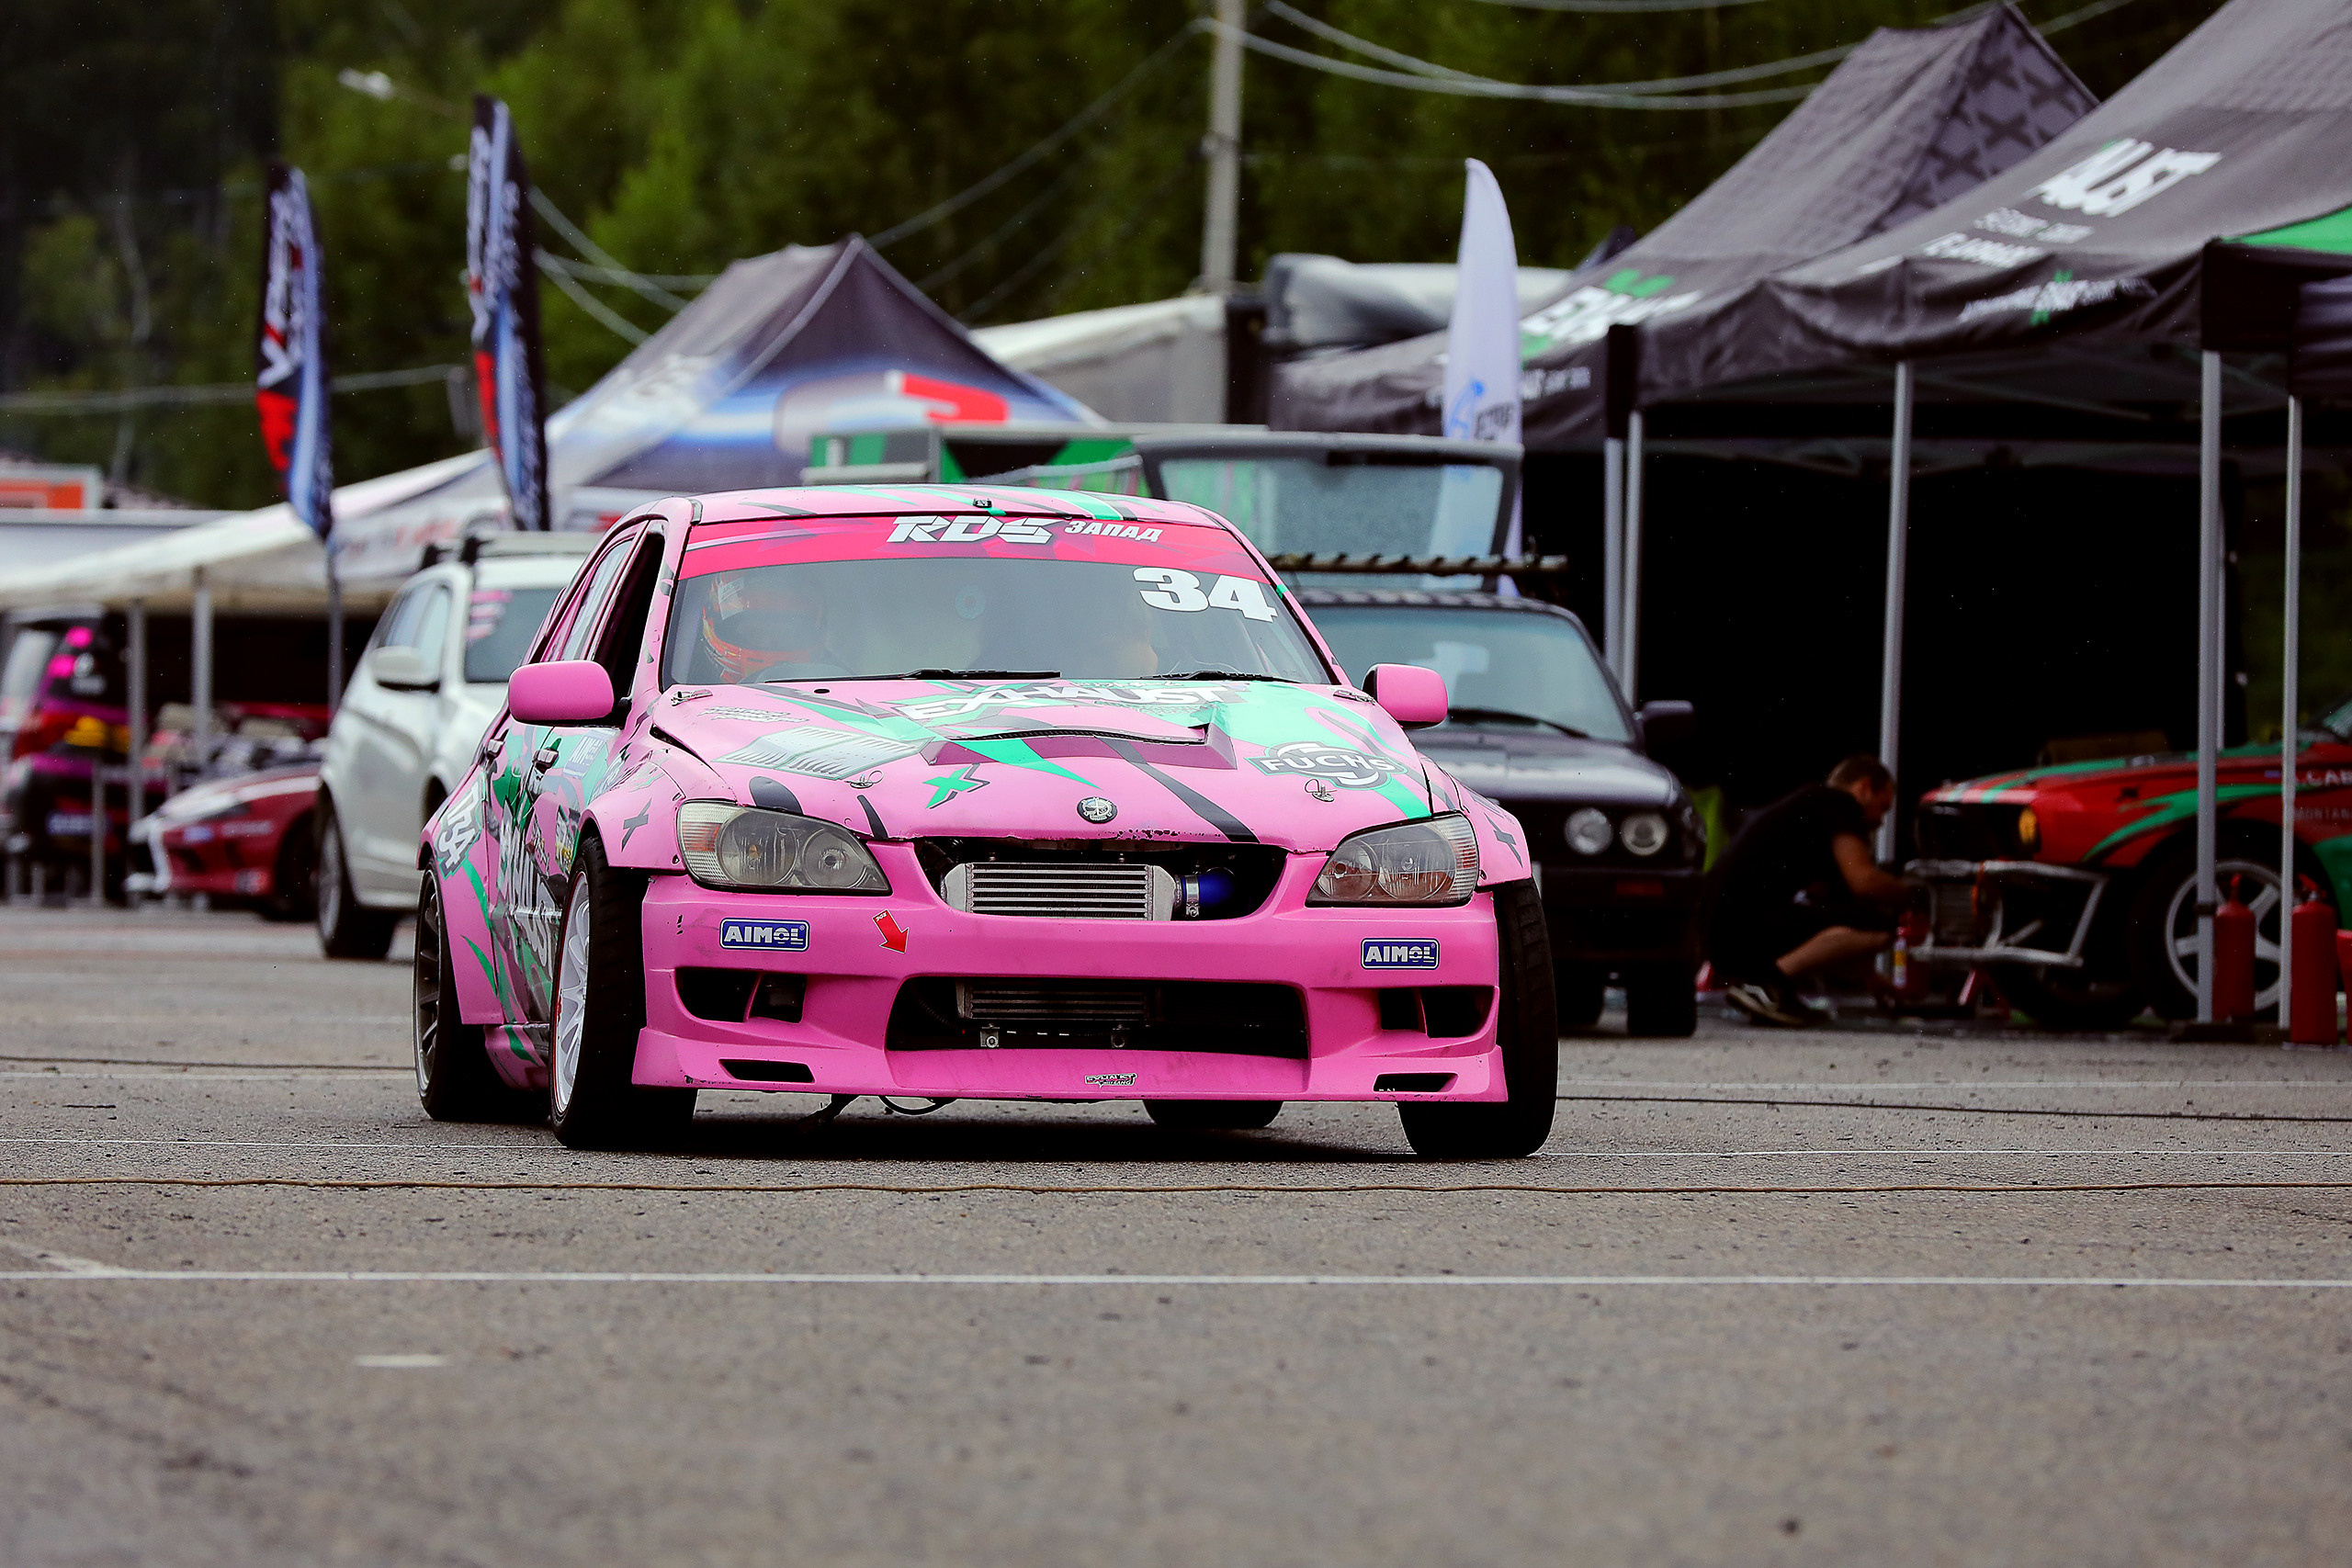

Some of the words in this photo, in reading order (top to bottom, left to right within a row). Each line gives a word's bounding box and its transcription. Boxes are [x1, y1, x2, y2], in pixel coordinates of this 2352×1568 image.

[887, 515, 1063, 544] RDS
[1064, 521, 1164, 543] ЗАПАД
[1133, 567, 1278, 623] 34
[893, 685, 1229, 721] EXHAUST
[1260, 754, 1396, 772] FUCHS
[724, 925, 804, 945] AIMOL
[1364, 946, 1435, 963] AIMOL
